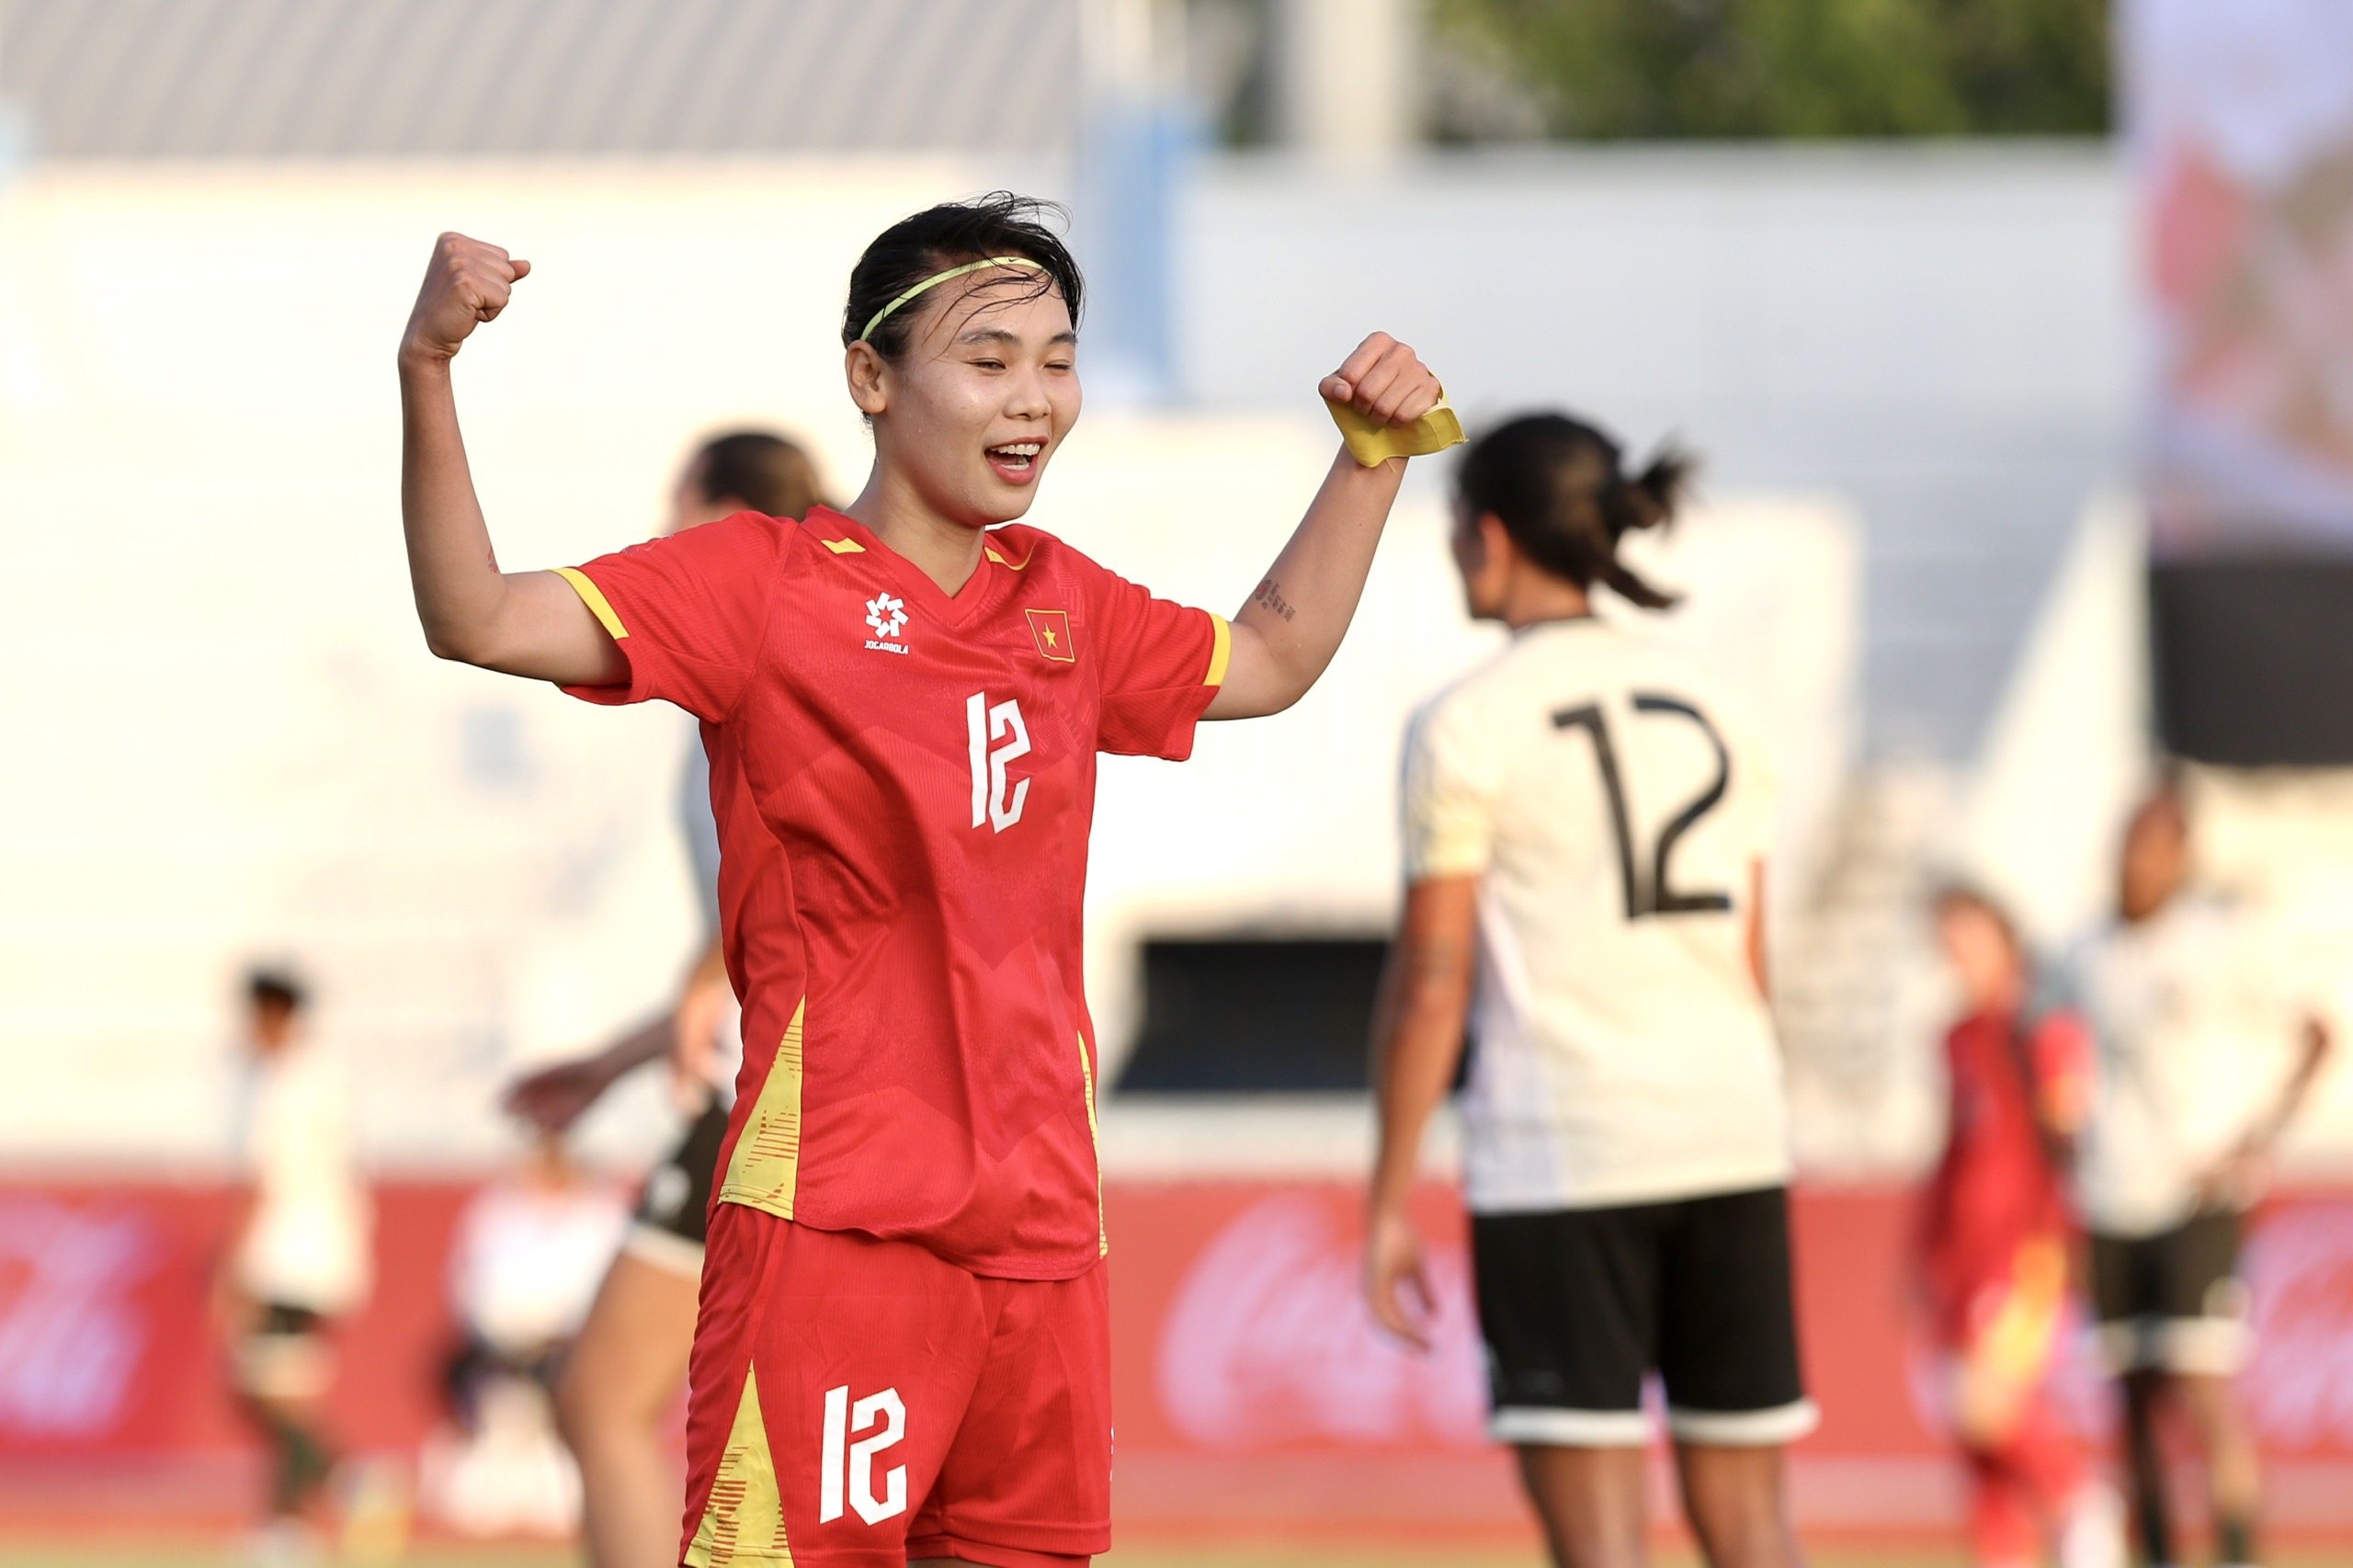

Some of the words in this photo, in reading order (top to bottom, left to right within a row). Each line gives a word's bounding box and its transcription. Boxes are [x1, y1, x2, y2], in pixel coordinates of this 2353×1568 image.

[864, 640, 909, 655] JOGARBOLA
[966, 691, 1031, 835] 12
[1552, 694, 1733, 923] 12
[819, 1384, 907, 1527] 12
